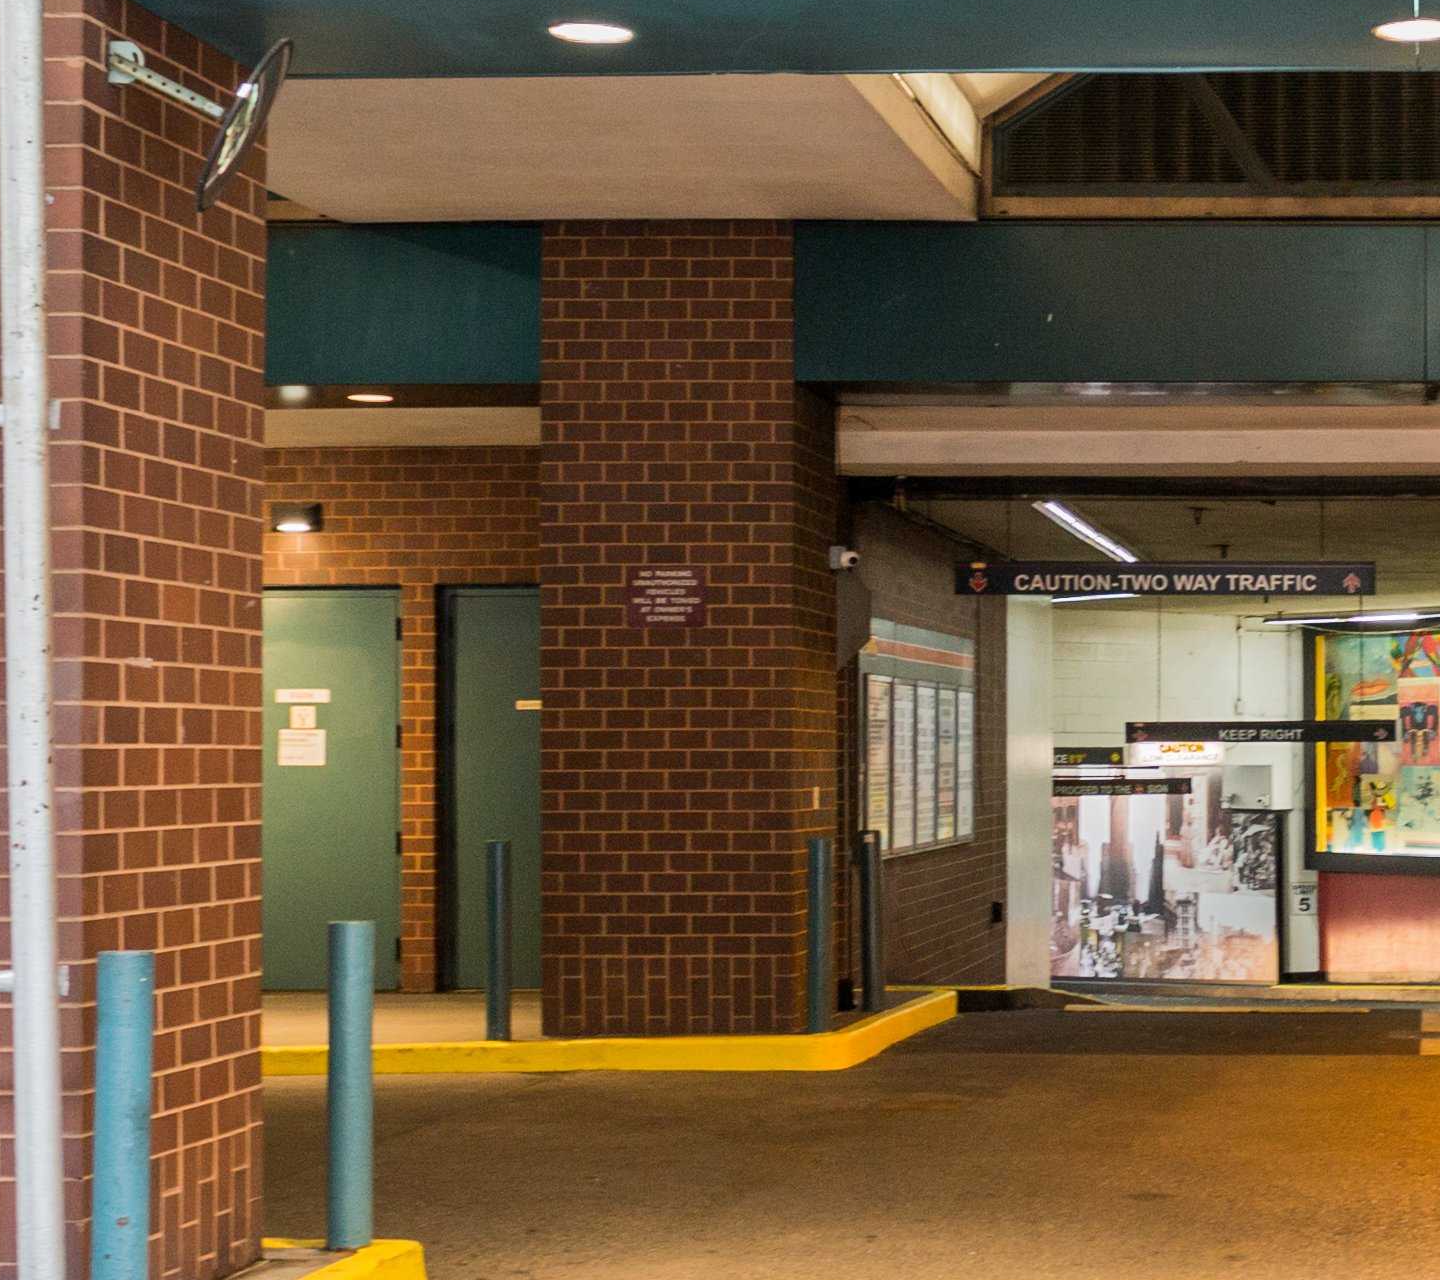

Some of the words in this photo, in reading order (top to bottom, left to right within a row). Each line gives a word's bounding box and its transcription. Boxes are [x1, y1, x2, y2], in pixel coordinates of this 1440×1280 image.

[1013, 573, 1168, 593] CAUTION-TWO
[1173, 573, 1222, 592] WAY
[1225, 573, 1318, 592] TRAFFIC
[1218, 728, 1257, 742] KEEP
[1260, 728, 1305, 742] RIGHT
[1299, 897, 1311, 912] 5
